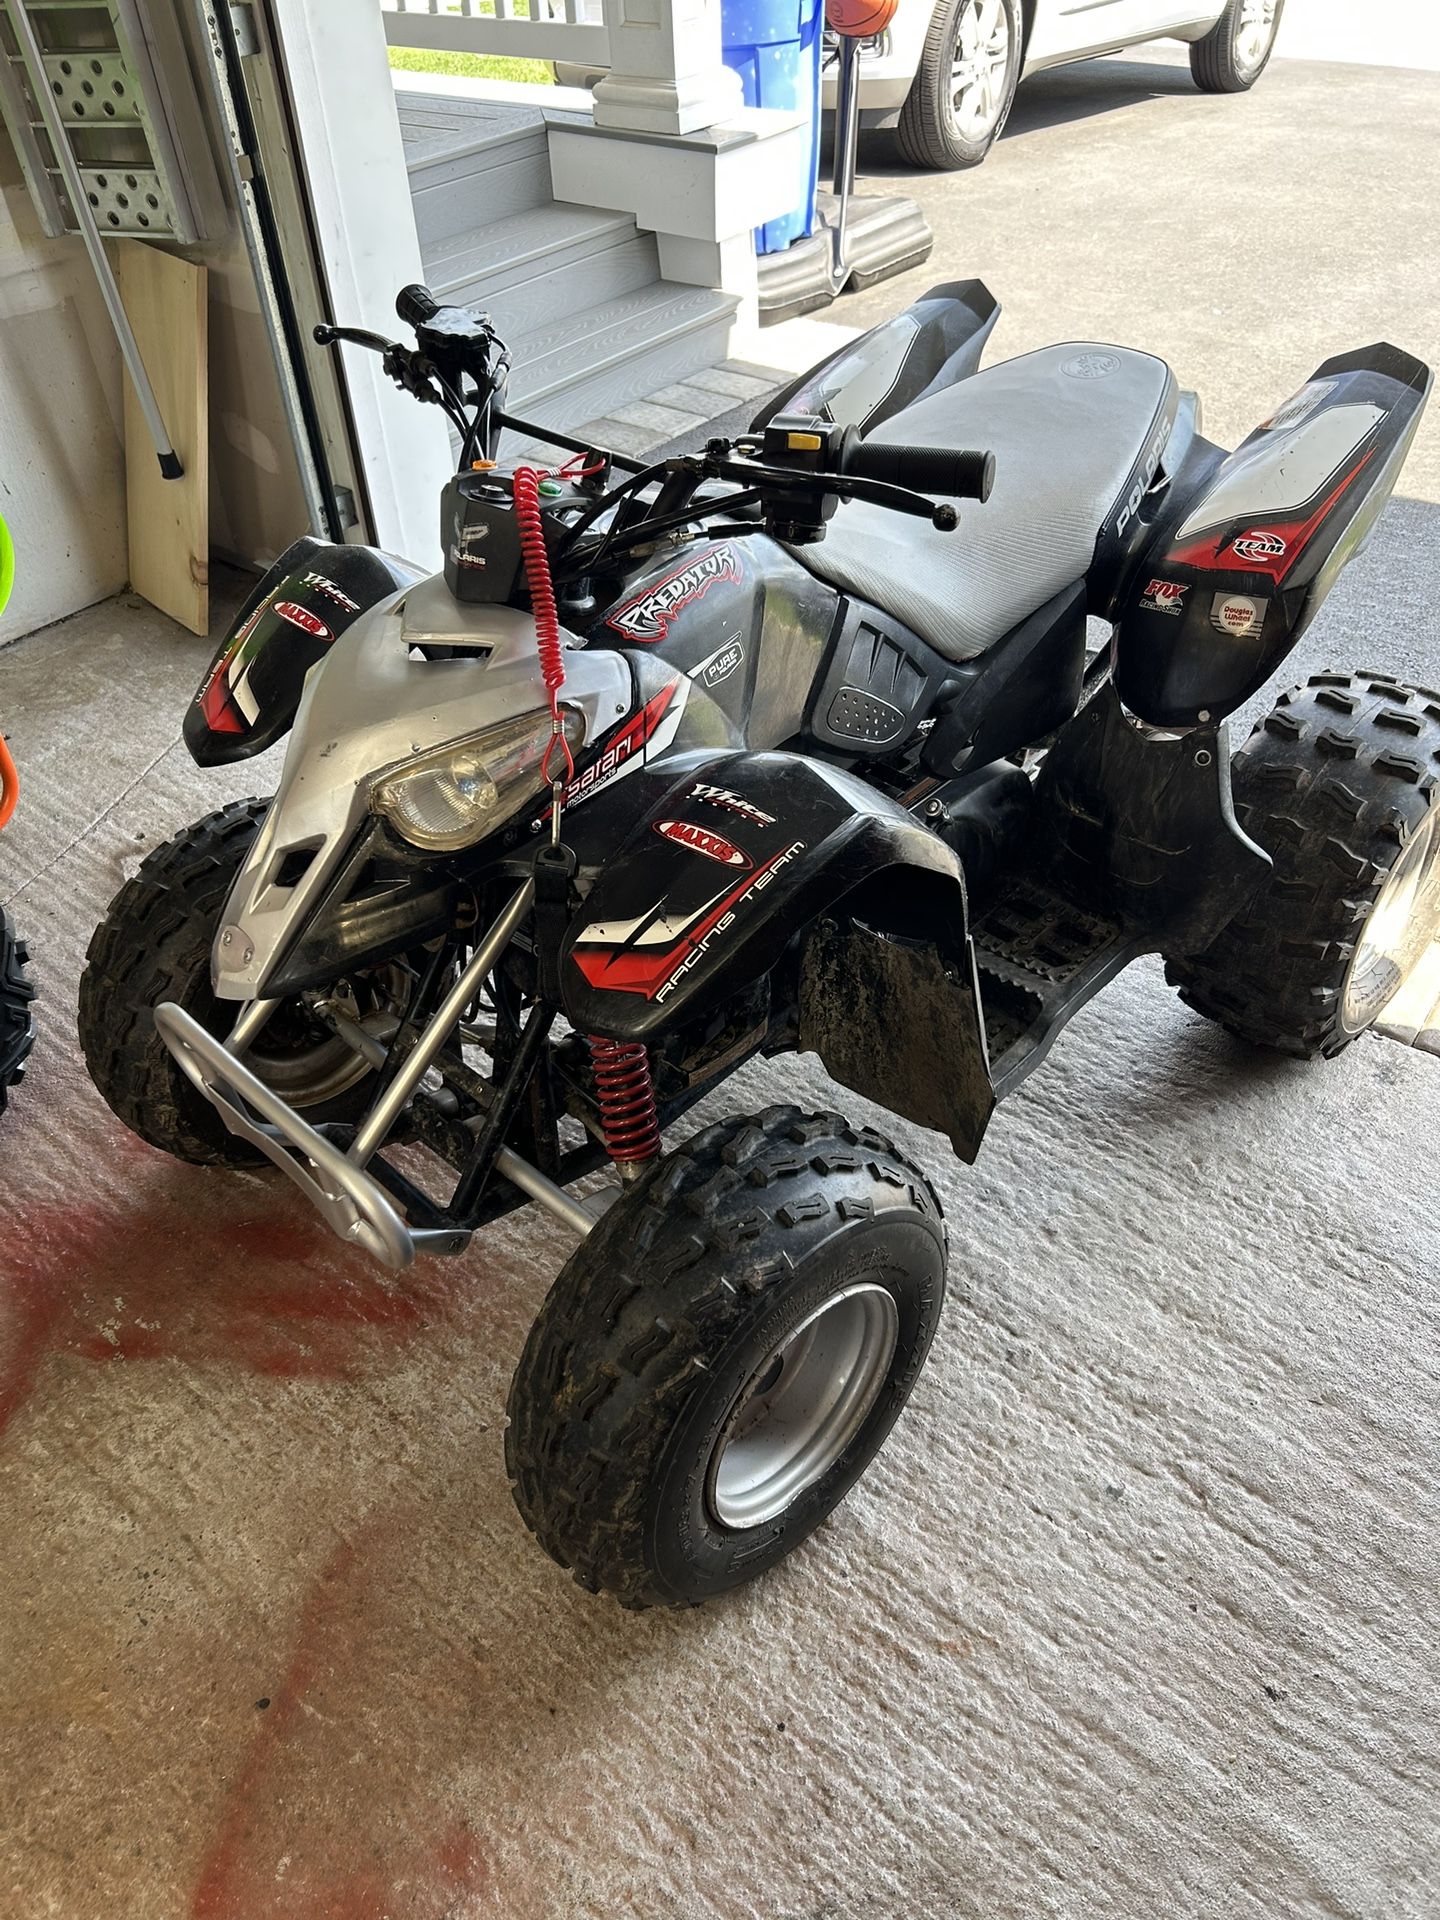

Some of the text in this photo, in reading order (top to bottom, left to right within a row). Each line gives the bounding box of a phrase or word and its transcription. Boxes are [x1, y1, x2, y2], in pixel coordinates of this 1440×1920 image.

[1116, 416, 1171, 537] POLARIS
[1234, 538, 1286, 555] TEAM
[611, 545, 738, 634] PREDATOR
[1144, 579, 1189, 599] FOX
[276, 602, 326, 636] MAXXIS
[1224, 606, 1254, 616] Douglas
[709, 648, 738, 677] PURE
[566, 767, 617, 808] motorsports
[664, 821, 737, 864] MAXXIS
[655, 841, 805, 1004] RACING TEAM
